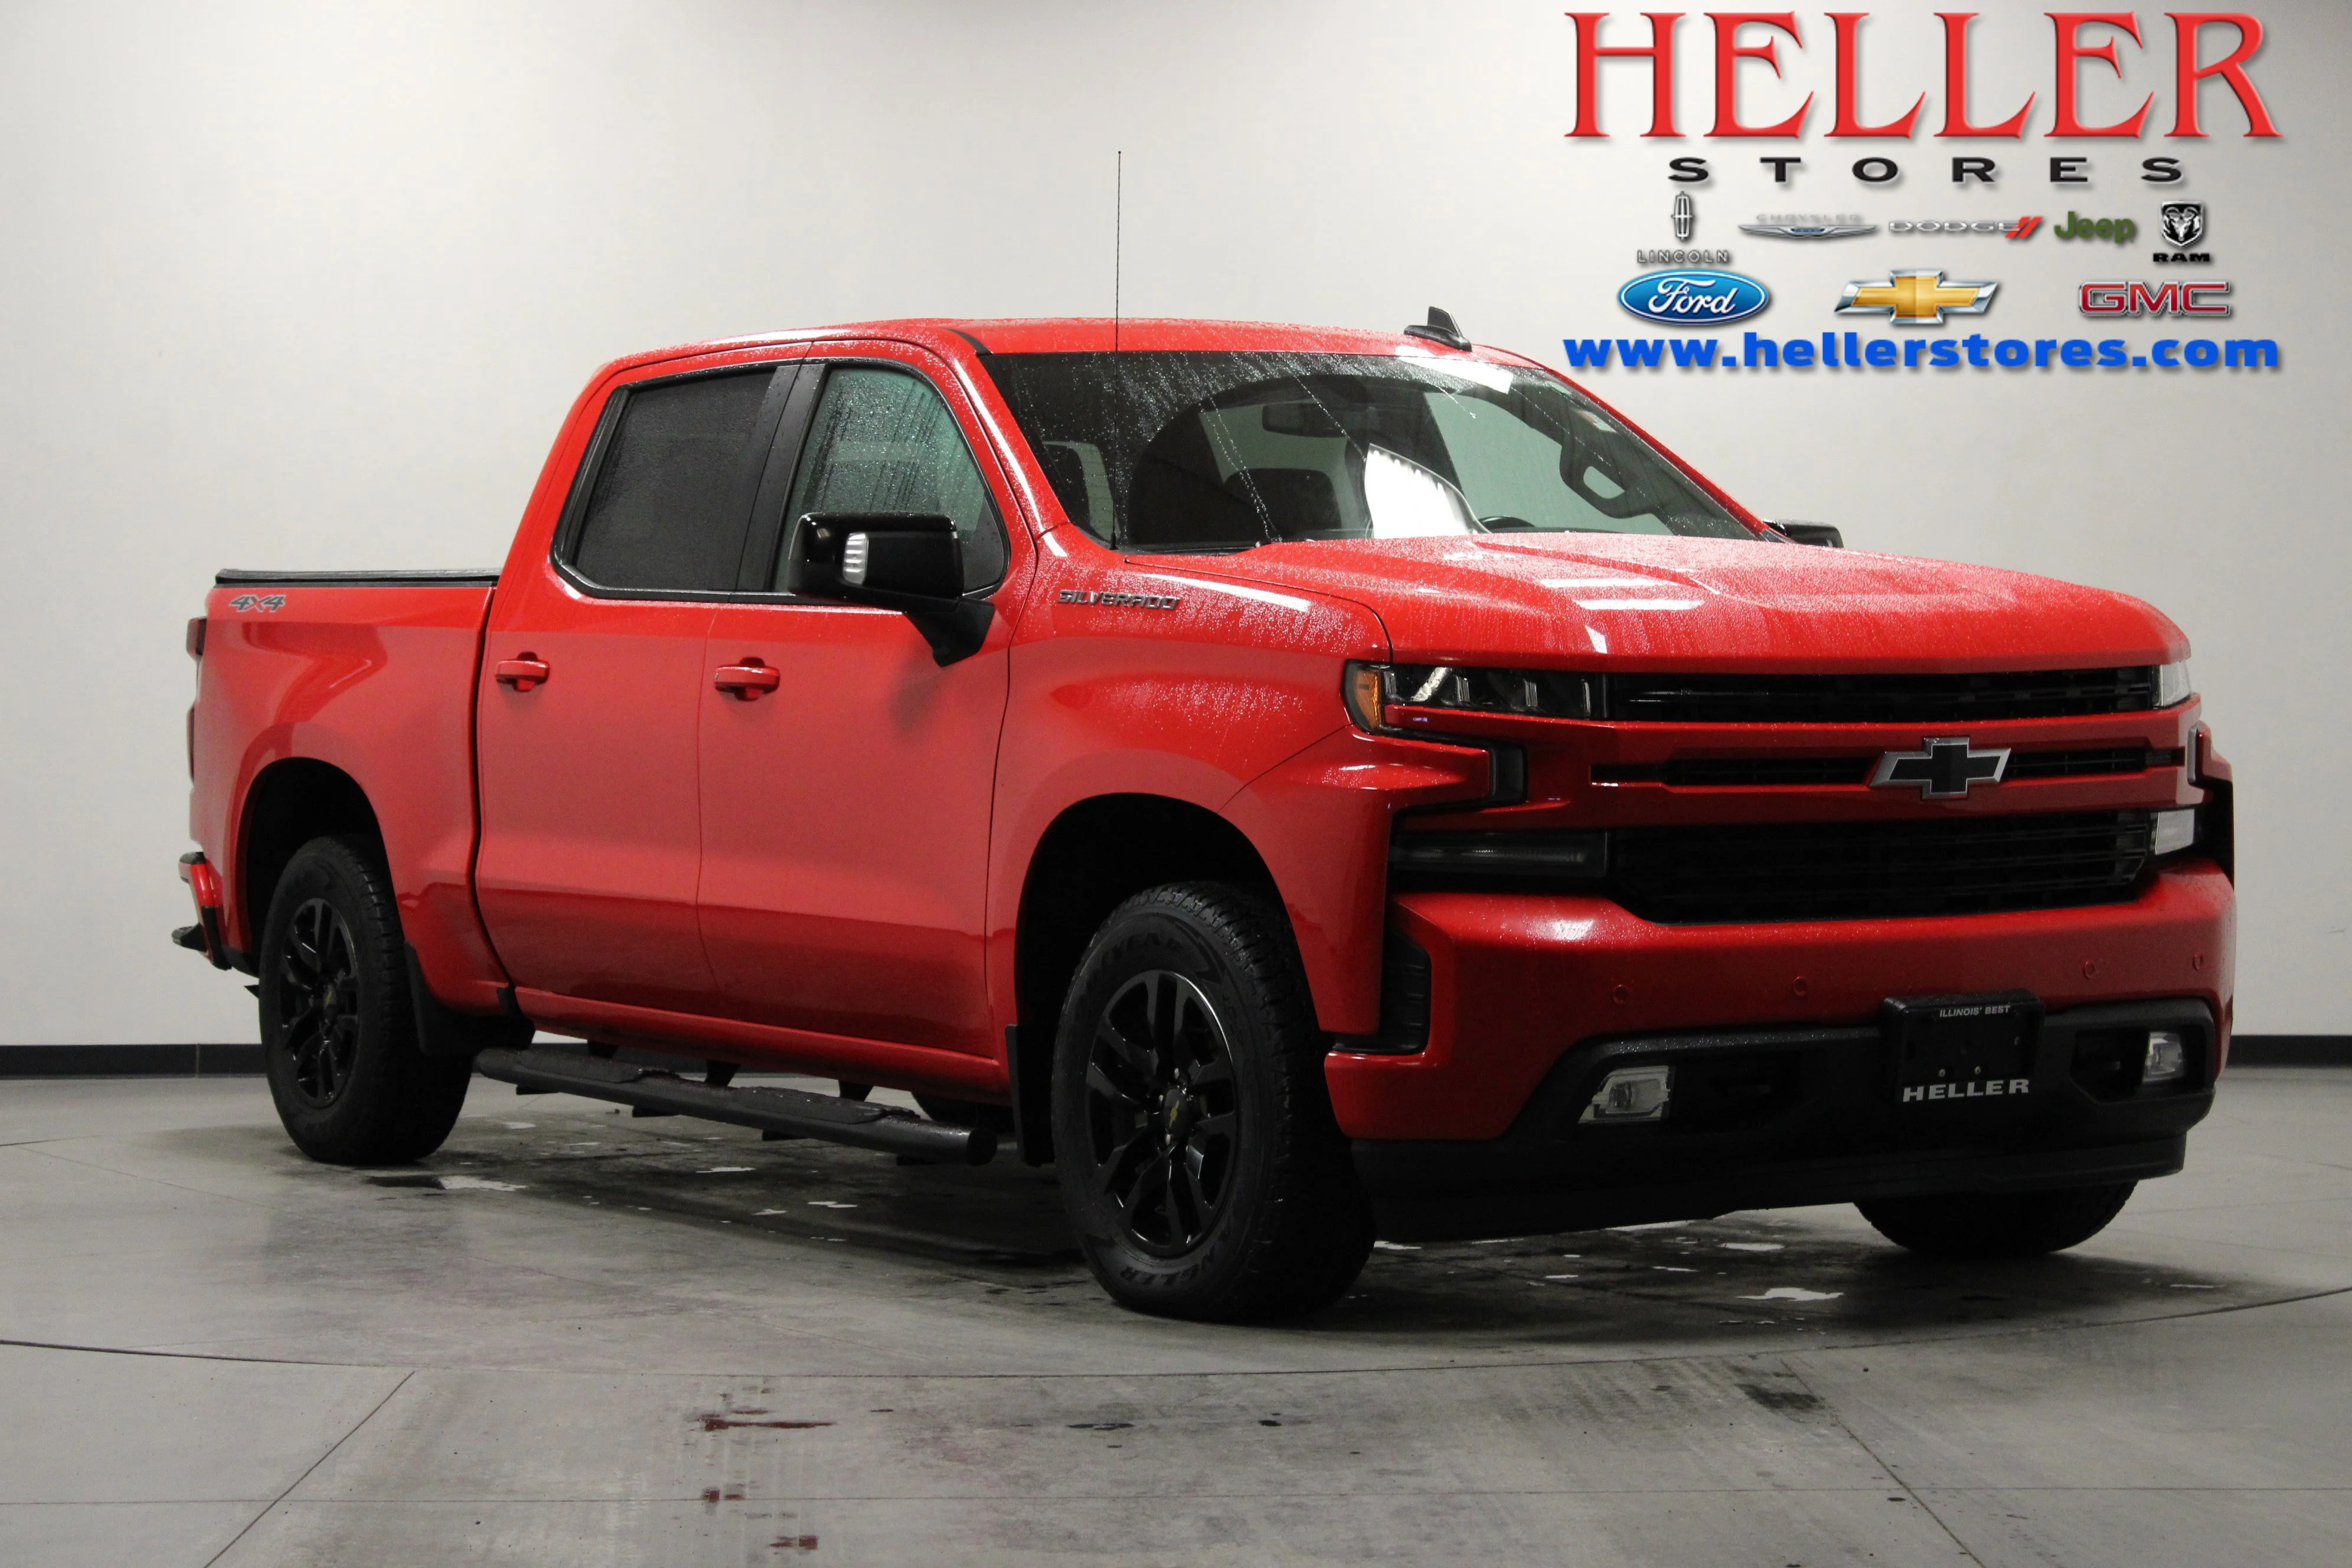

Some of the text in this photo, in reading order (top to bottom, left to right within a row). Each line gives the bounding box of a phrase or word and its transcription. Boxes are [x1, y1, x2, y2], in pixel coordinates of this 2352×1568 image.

[1057, 590, 1180, 610] SILVERADO
[1984, 1005, 2011, 1015] BEST
[1903, 1079, 2030, 1103] HELLER
